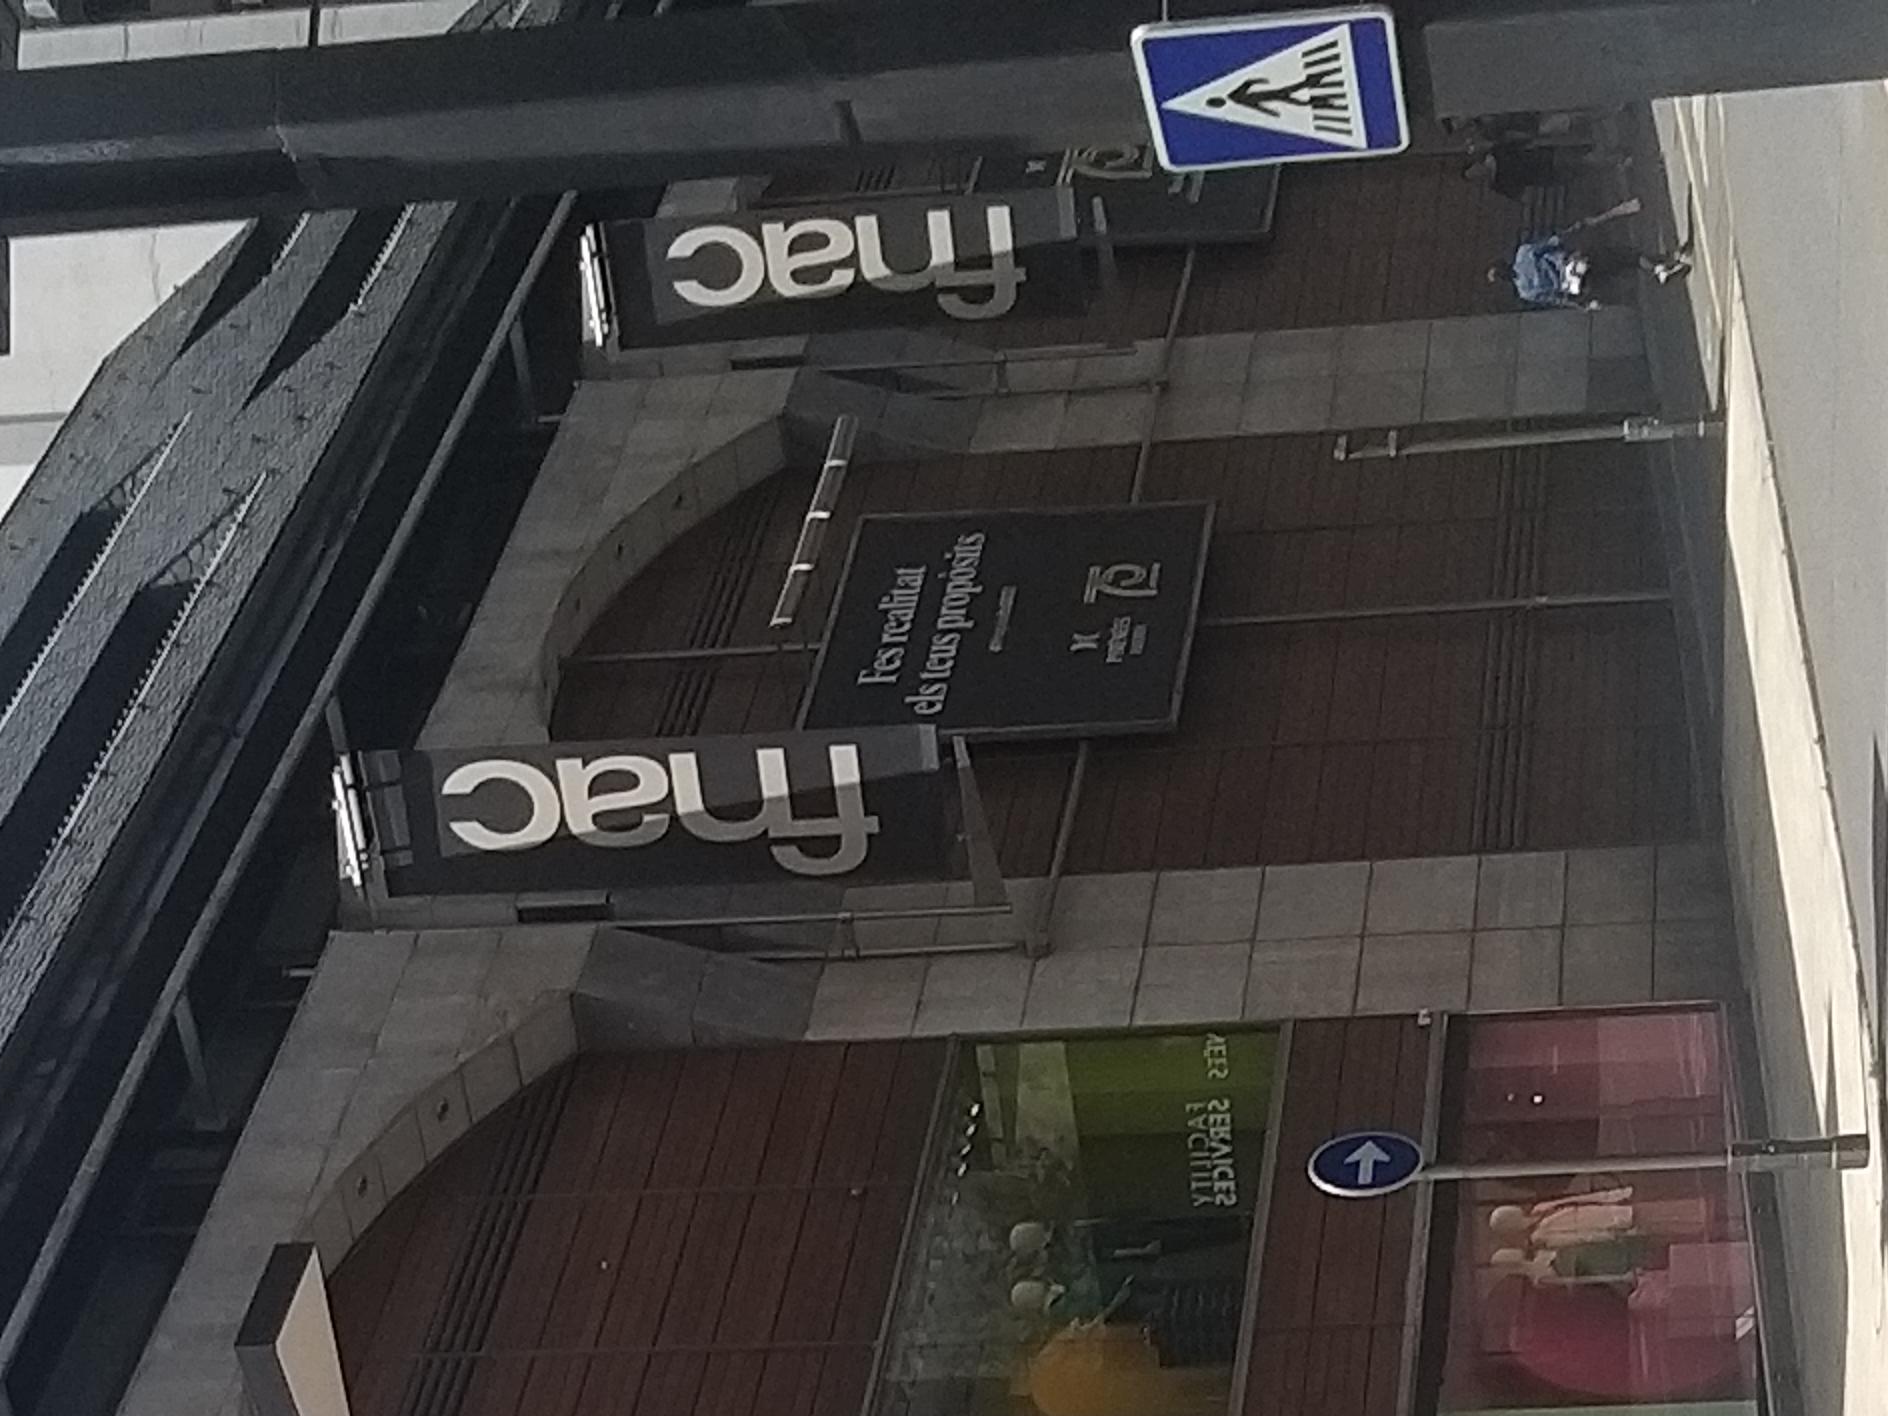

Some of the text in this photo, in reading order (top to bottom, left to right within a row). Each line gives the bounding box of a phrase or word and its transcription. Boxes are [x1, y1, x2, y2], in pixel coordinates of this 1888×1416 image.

[665, 206, 1027, 318] fnac
[856, 564, 927, 686] Fes realitat
[904, 532, 985, 714] els teus propòsits
[1083, 564, 1158, 603] 75
[441, 743, 878, 875] fnac
